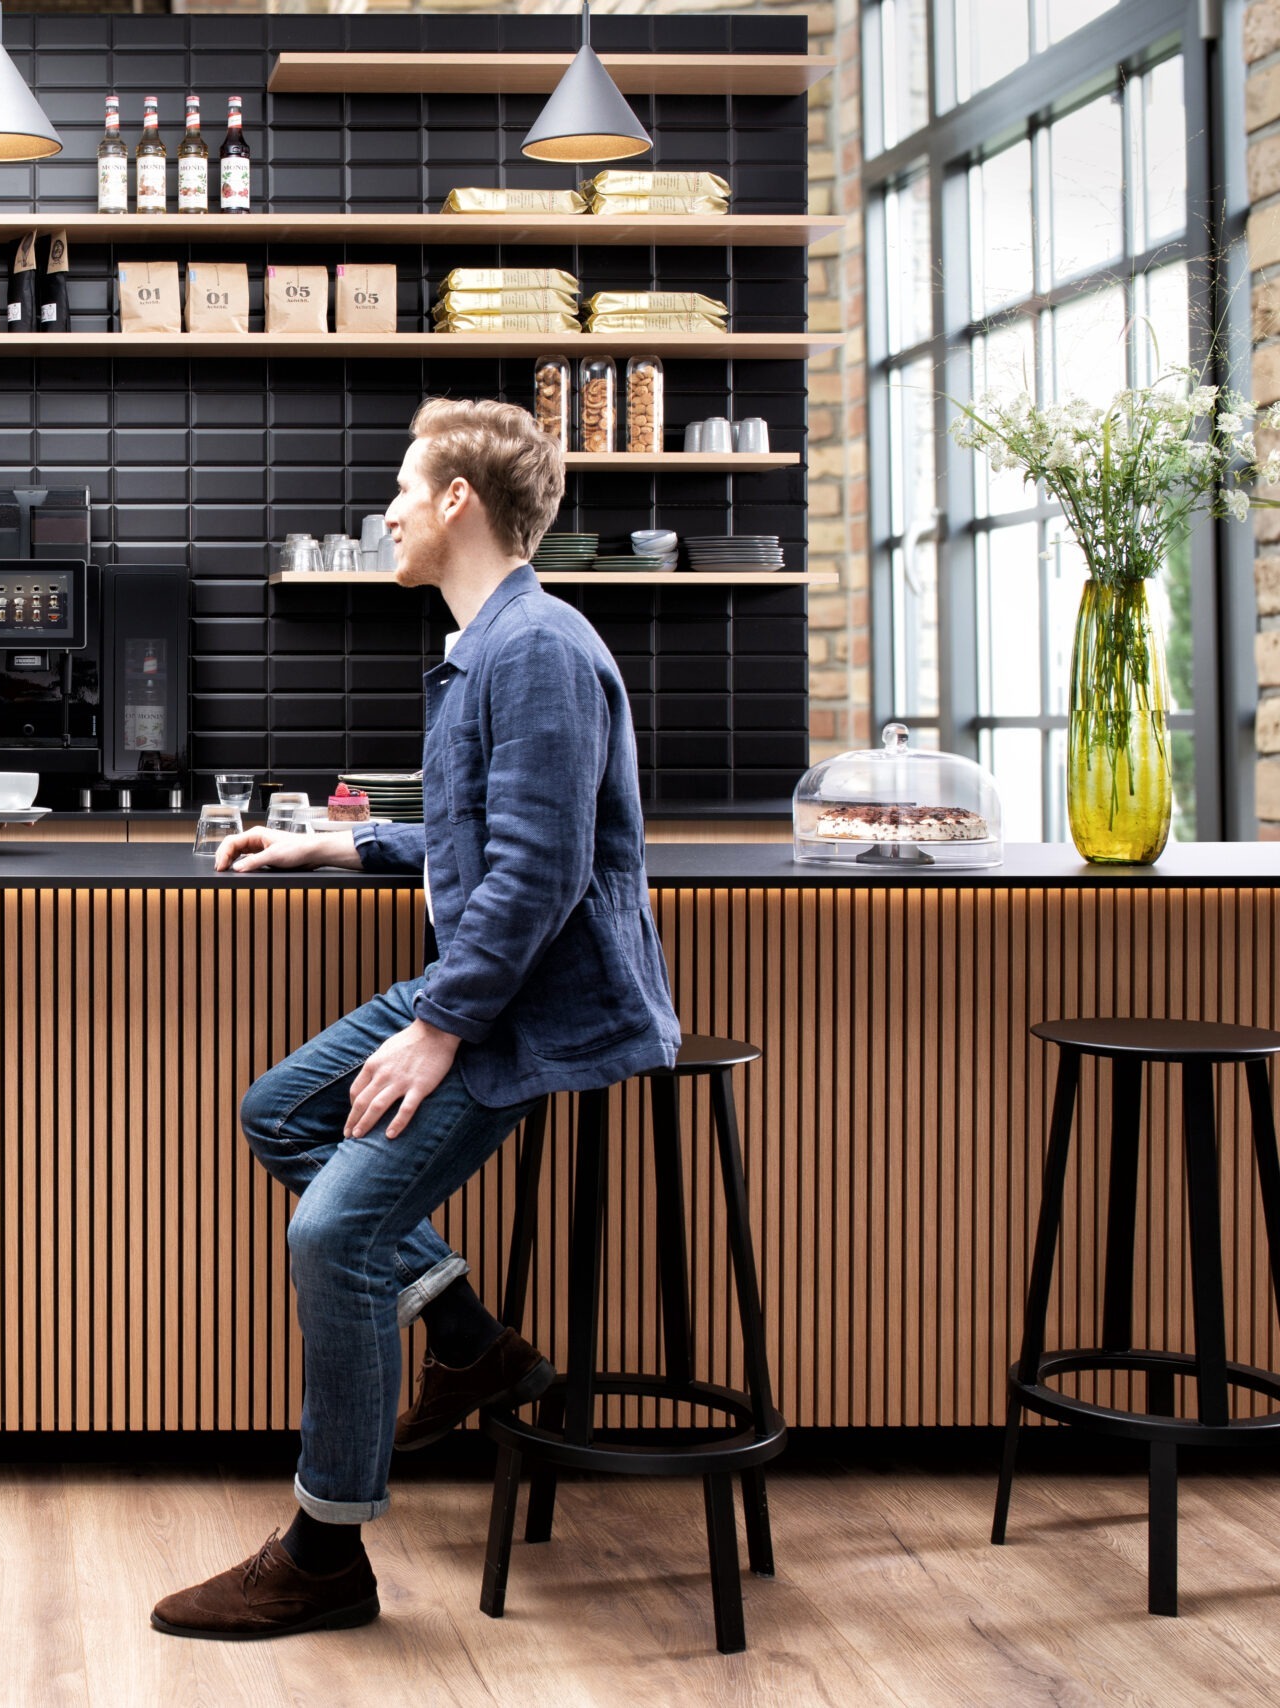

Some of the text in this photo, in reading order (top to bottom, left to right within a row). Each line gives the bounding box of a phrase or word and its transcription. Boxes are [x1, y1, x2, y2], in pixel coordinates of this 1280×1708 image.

[138, 288, 160, 301] 01
[285, 286, 310, 297] 05
[206, 292, 228, 305] 01
[354, 292, 379, 304] 05
